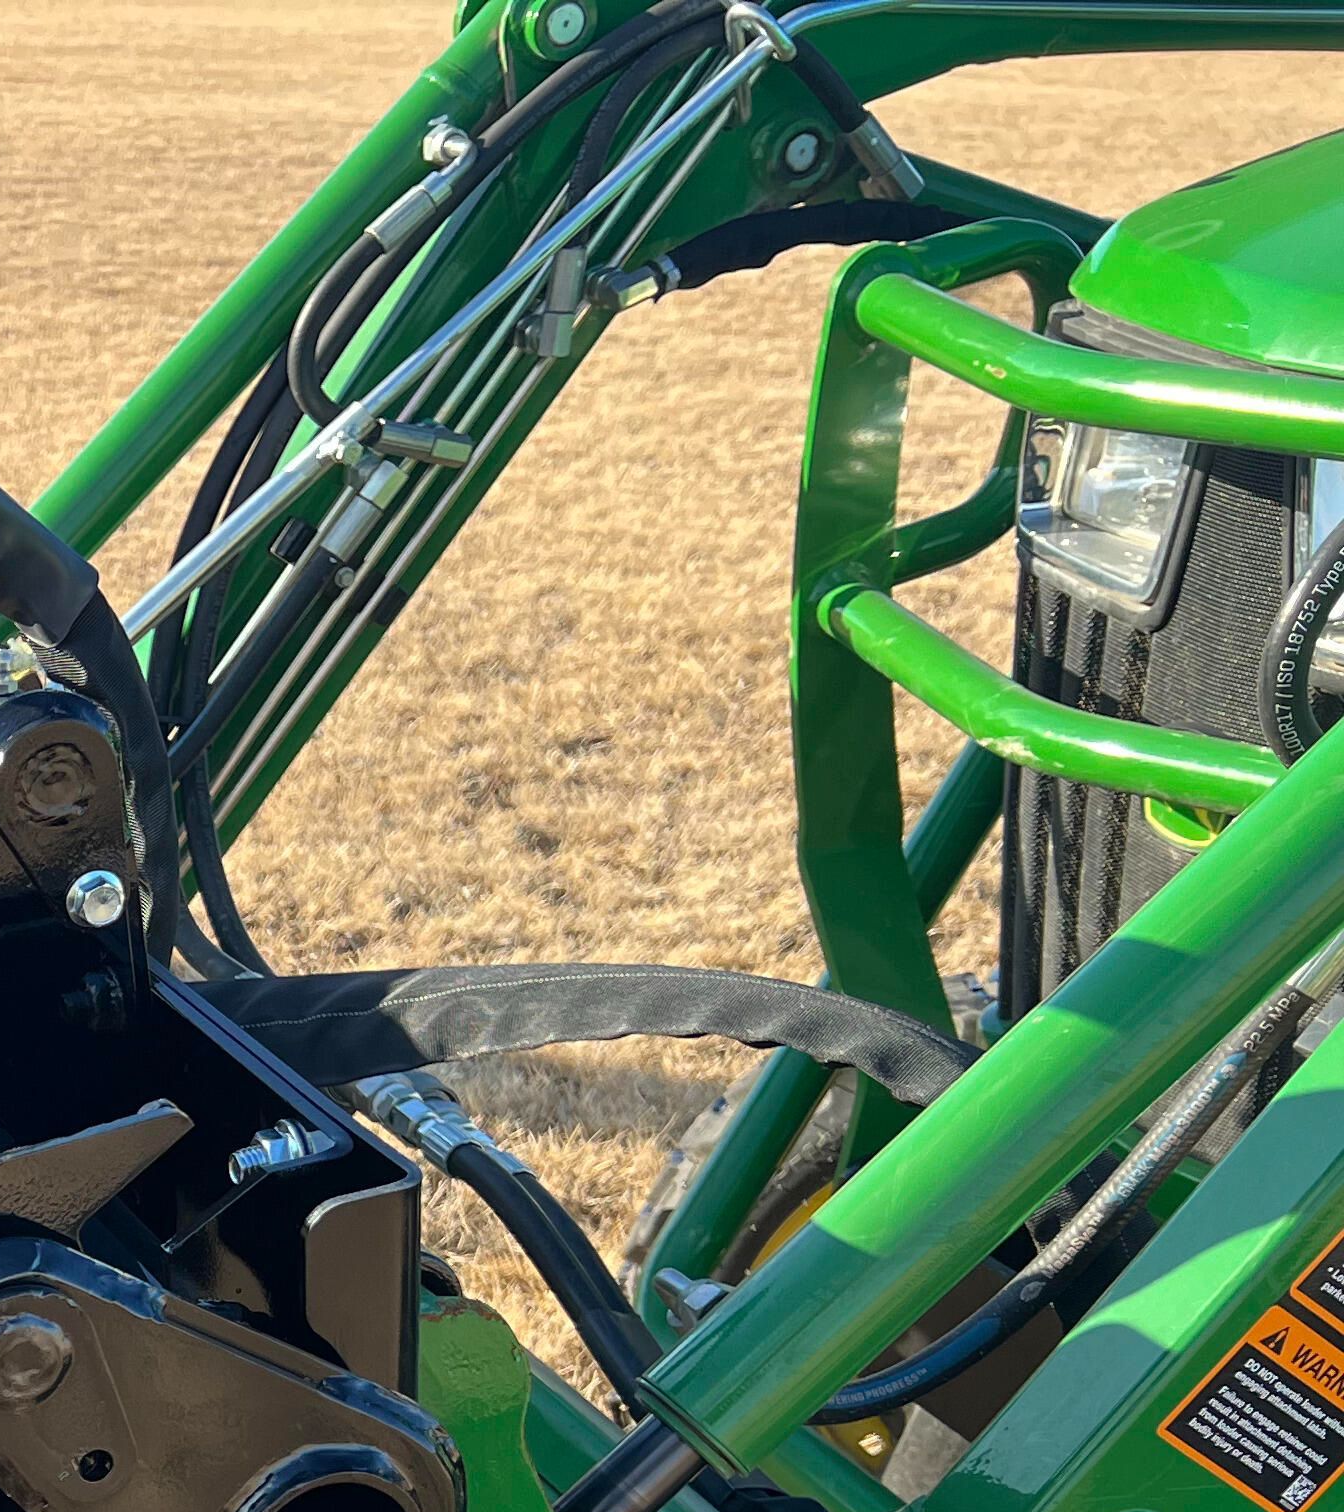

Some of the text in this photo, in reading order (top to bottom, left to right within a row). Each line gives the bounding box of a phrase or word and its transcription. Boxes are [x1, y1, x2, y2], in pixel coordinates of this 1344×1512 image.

[1312, 560, 1344, 596] Type
[1285, 599, 1321, 655] 18752
[1276, 662, 1295, 688] ISO
[1275, 704, 1305, 757] 100R17
[1271, 991, 1300, 1021] MPa
[1320, 1281, 1344, 1305] parke
[1243, 1358, 1260, 1373] DO
[1258, 1368, 1279, 1384] NOT
[1274, 1382, 1303, 1405] operate
[1301, 1399, 1326, 1420] loader
[1291, 1343, 1344, 1399] WARN
[1217, 1385, 1329, 1466] Failure to engage retainer could
[1234, 1371, 1327, 1440] engaging attachment latch.
[1188, 1417, 1264, 1474] bodily injury or death.
[1197, 1407, 1295, 1478] from loader causing serious
[1208, 1398, 1313, 1475] result in attachment detaching
